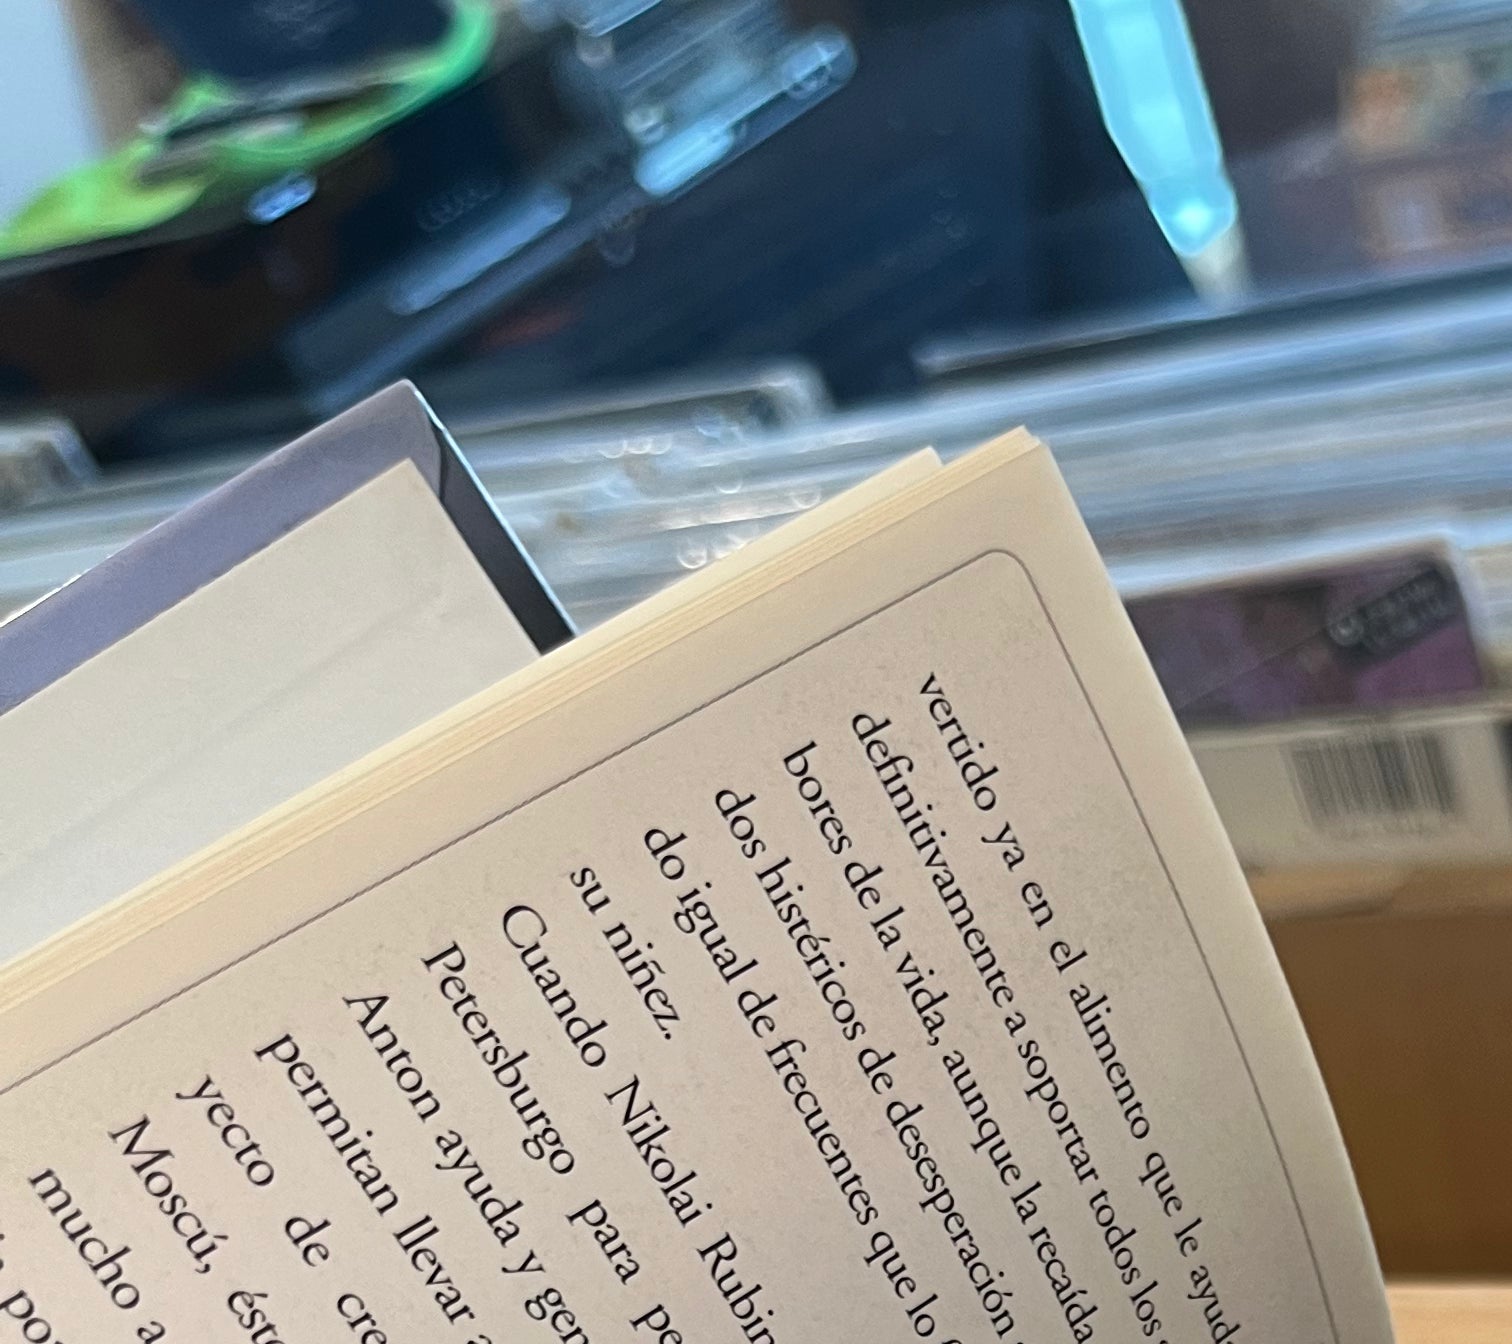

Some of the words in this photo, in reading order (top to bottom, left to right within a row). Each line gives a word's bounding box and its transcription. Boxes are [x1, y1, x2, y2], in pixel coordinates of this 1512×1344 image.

[919, 671, 1000, 812] vertido
[980, 820, 1026, 873] ya
[569, 866, 612, 916] su
[601, 921, 681, 1041] niñez.
[782, 739, 853, 855] bores
[843, 861, 885, 911] de
[869, 905, 906, 953] la
[895, 950, 950, 1047] vida,
[941, 1049, 1022, 1187] aunque
[1009, 1180, 1043, 1226] la
[1020, 881, 1054, 932] en
[1048, 940, 1089, 975] el
[341, 995, 441, 1124] Anton
[434, 1129, 525, 1249] ayuda
[500, 1248, 547, 1274] y
[420, 940, 575, 1175] Petersburgo
[564, 1198, 641, 1286] para
[502, 904, 609, 1068] Cuando
[603, 1073, 713, 1229] Nikolai
[643, 828, 689, 881] do
[672, 881, 760, 986] igual
[736, 989, 779, 1039] de
[764, 1038, 879, 1226] frecuentes
[862, 1230, 917, 1300] que
[904, 1292, 939, 1338] lo
[714, 788, 767, 860] dos
[754, 855, 867, 1042] histéricos
[857, 1047, 897, 1096] de
[885, 1100, 1015, 1340] desesperación
[851, 713, 1014, 1009] definitivamente
[1003, 1010, 1027, 1039] a
[1017, 1039, 1100, 1186] soportar
[1088, 1188, 1142, 1286] todos
[1128, 1279, 1162, 1337] los
[1068, 983, 1151, 1140] alimento
[253, 1032, 399, 1217] permitan
[392, 1214, 476, 1326] llevar
[1137, 1151, 1183, 1218] que
[1173, 1216, 1203, 1258] le
